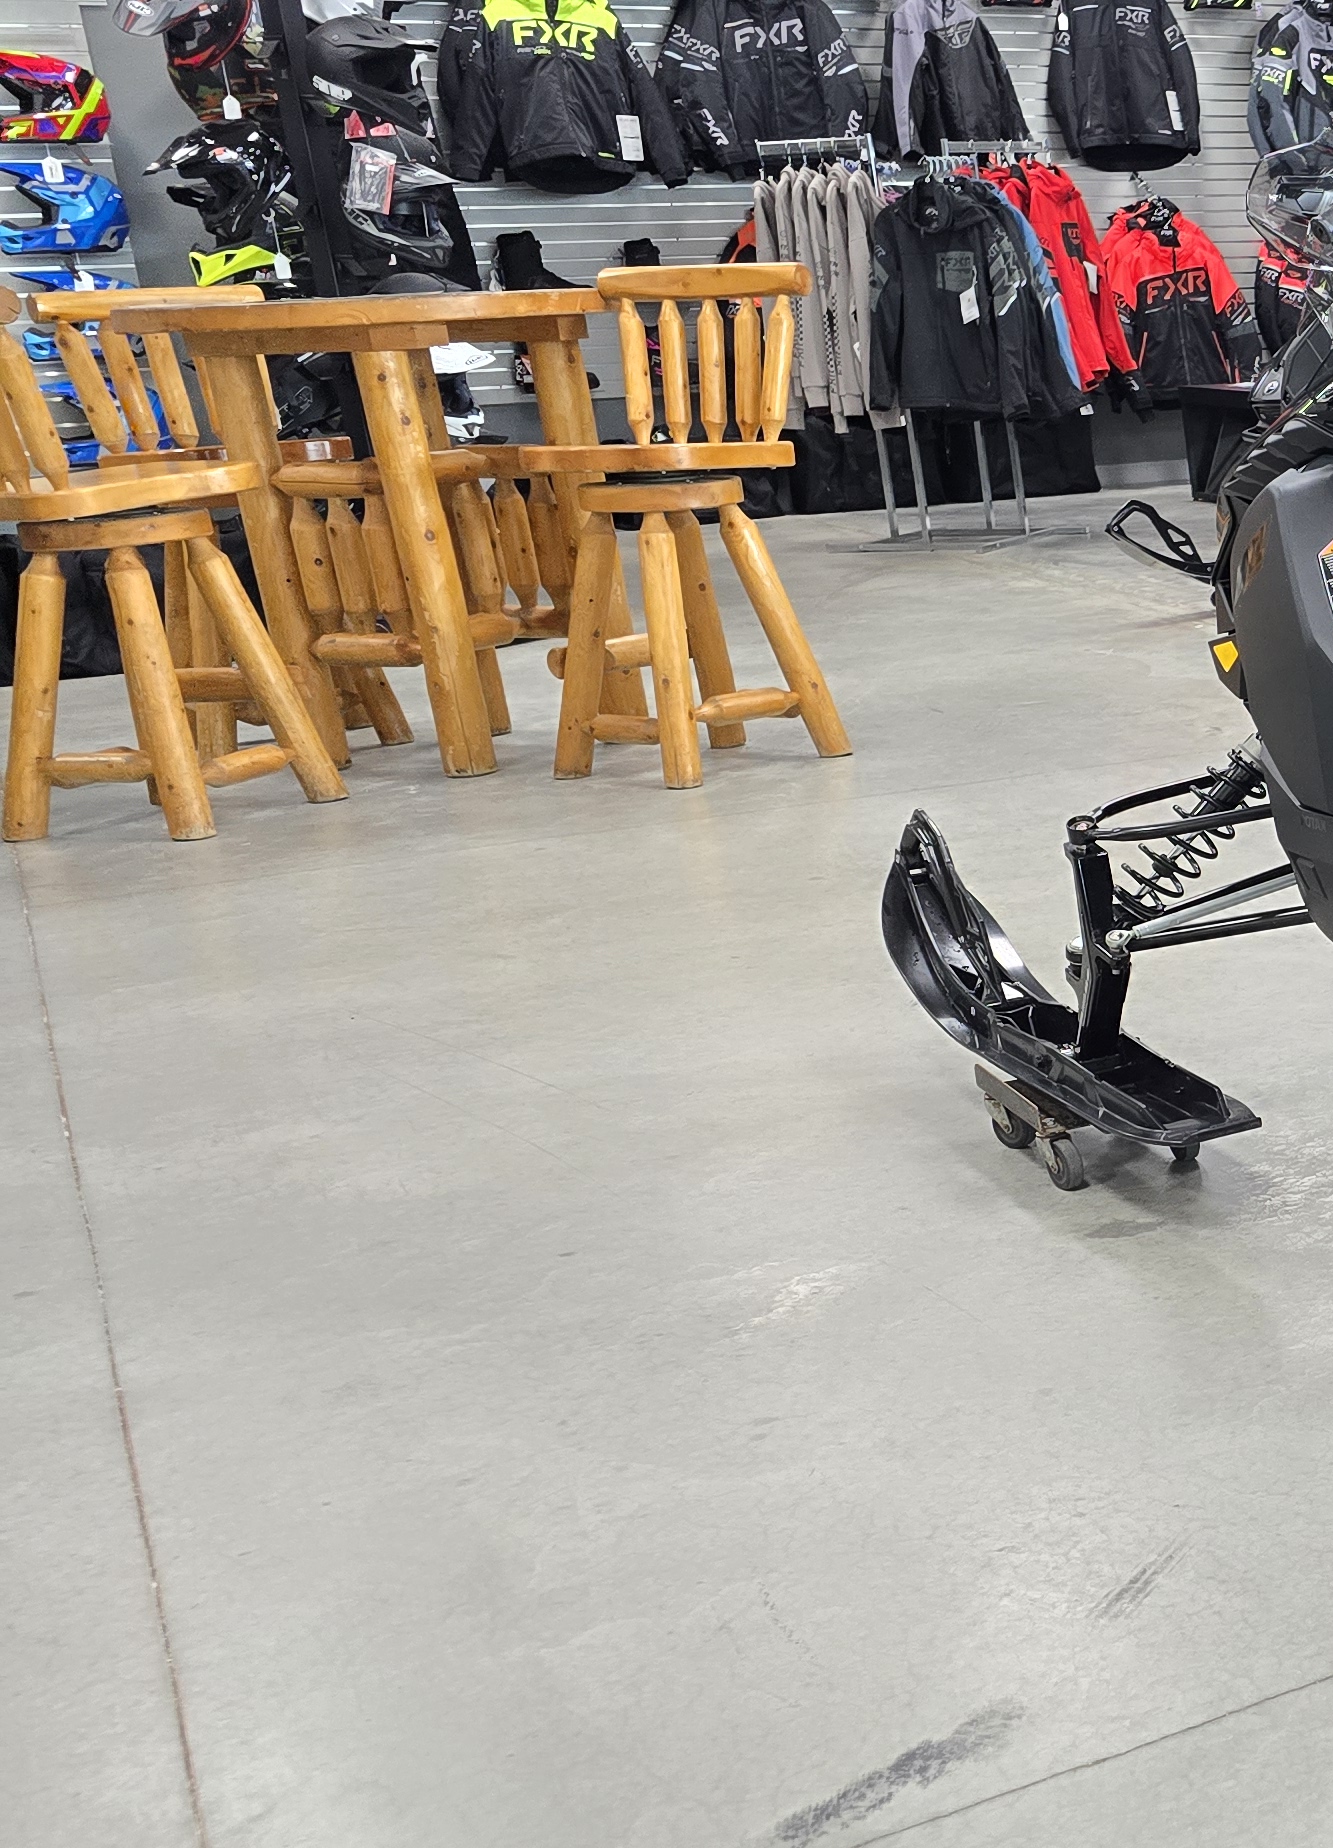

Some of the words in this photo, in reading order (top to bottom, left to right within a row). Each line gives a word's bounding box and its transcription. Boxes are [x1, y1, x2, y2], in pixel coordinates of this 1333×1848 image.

[1116, 7, 1150, 25] FXR
[512, 20, 598, 52] FXR
[685, 37, 720, 62] FXR
[734, 18, 804, 53] FXR
[817, 34, 849, 65] FXR
[702, 108, 729, 146] FXR
[844, 110, 862, 138] XR
[1146, 271, 1206, 304] FXR
[1277, 289, 1304, 304] FXR
